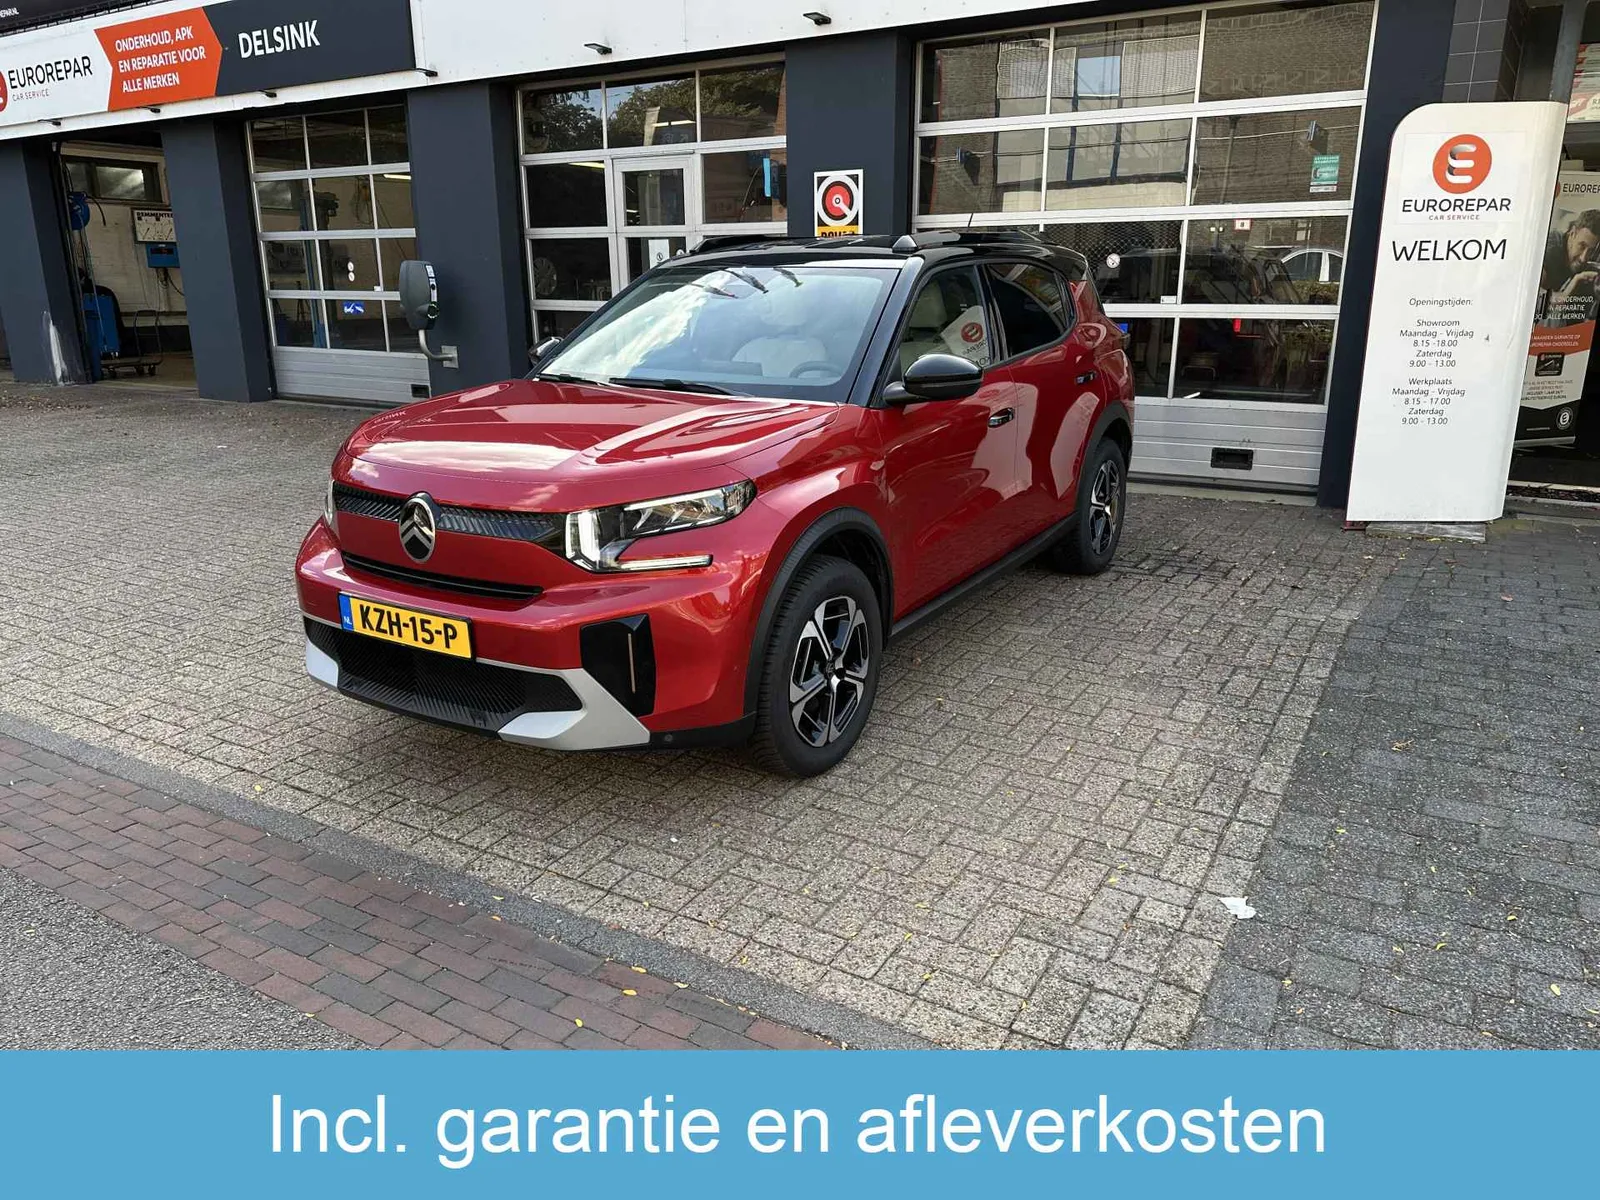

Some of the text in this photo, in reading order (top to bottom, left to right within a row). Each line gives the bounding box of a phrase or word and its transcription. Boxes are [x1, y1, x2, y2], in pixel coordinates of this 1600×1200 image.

[115, 26, 193, 53] ONDERHOUD, APK
[238, 19, 321, 59] DELSINK
[118, 46, 206, 73] EN REPARATIE VOOR
[8, 55, 93, 90] EUROREPAR
[122, 71, 180, 93] ALLE MERKEN
[12, 88, 49, 102] CAR SERVICE
[1402, 198, 1512, 213] EUROREPAR
[1392, 239, 1508, 262] WELKOM
[1409, 297, 1473, 308] Openingstijden:
[1555, 304, 1585, 312] REPARATIE
[1547, 312, 1561, 320] ALLE
[1562, 312, 1586, 320] MERKEN
[1416, 318, 1460, 327] Showroom
[1399, 329, 1438, 339] Maandag
[1446, 328, 1474, 339] Vrijdag
[1413, 339, 1430, 347] 8.15
[1416, 349, 1453, 359] Zaterdag
[1409, 359, 1426, 368] 9.00
[1435, 359, 1456, 368] 13.00
[1408, 377, 1453, 386] Werkplaats
[1392, 387, 1429, 397] Maandag
[1437, 387, 1466, 397] Vrijdag
[1404, 397, 1421, 405] 8.15
[1430, 397, 1451, 405] 17.00
[1408, 407, 1445, 416] Zaterdag
[1401, 417, 1419, 425] 9.00
[1427, 417, 1448, 425] 13.00
[343, 604, 458, 649] NL KZH-15-P
